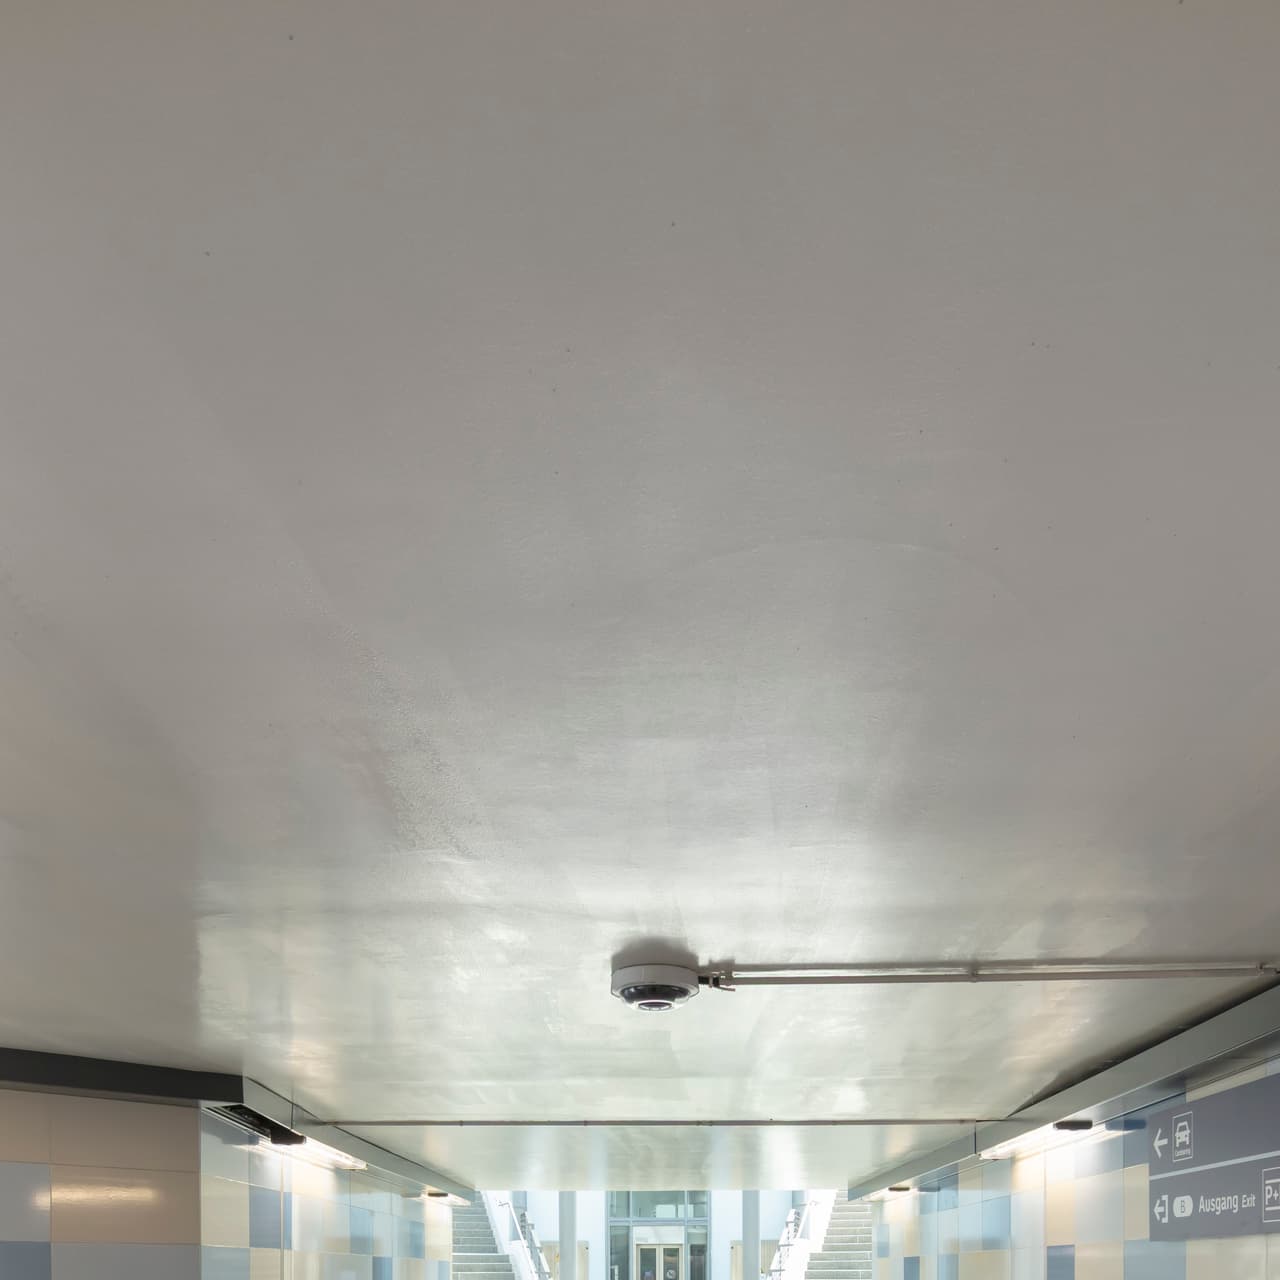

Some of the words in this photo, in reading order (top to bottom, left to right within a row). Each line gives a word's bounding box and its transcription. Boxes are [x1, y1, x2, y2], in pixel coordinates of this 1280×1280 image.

[1180, 1199, 1186, 1213] B
[1198, 1194, 1239, 1215] Ausgang
[1241, 1193, 1256, 1208] Exit
